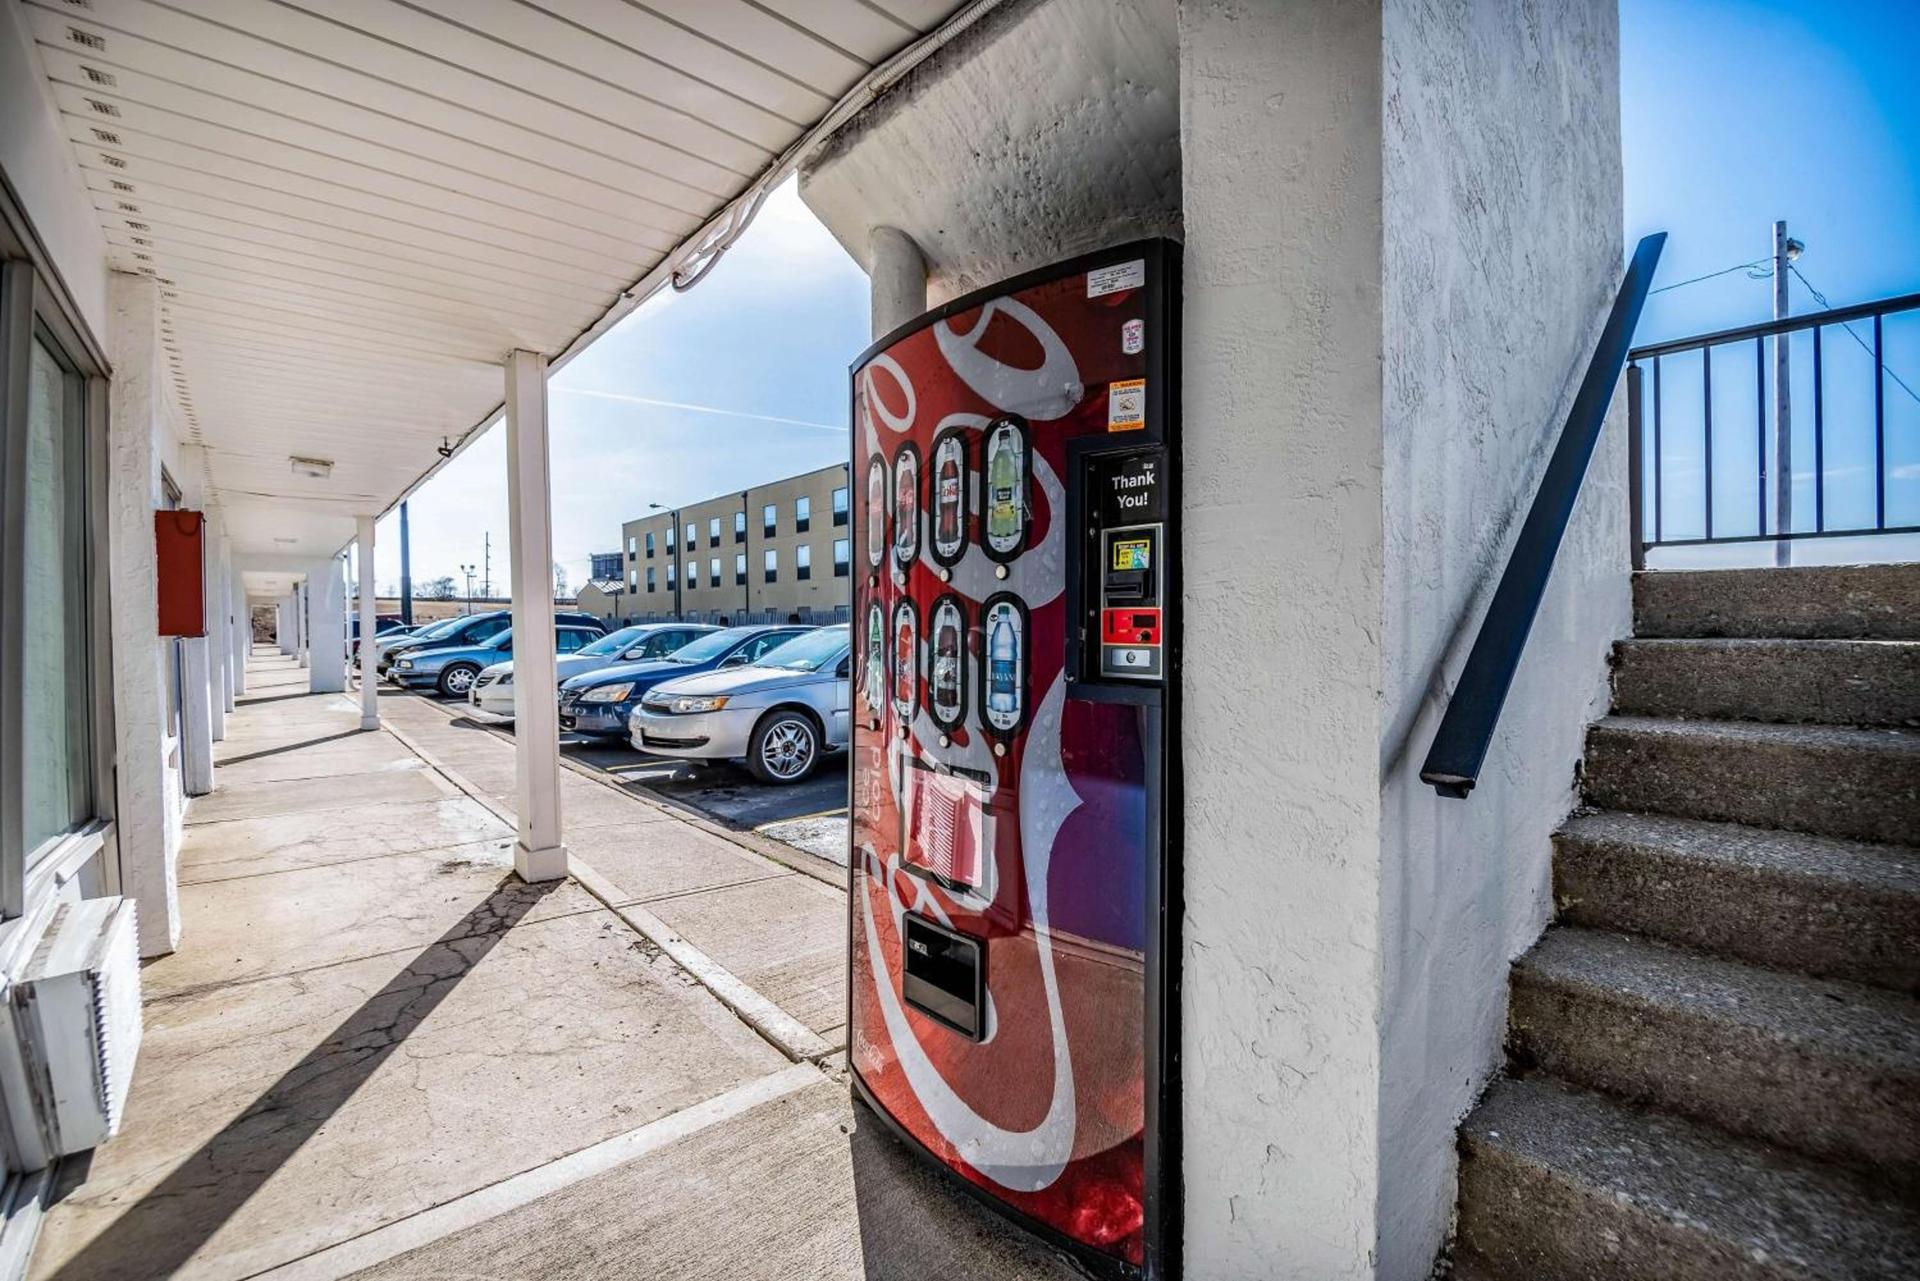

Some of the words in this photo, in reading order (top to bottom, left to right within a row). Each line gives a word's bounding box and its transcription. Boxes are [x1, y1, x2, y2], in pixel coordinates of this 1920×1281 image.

[1112, 471, 1155, 490] Thank
[1117, 492, 1148, 509] You!
[870, 746, 880, 821] cold
